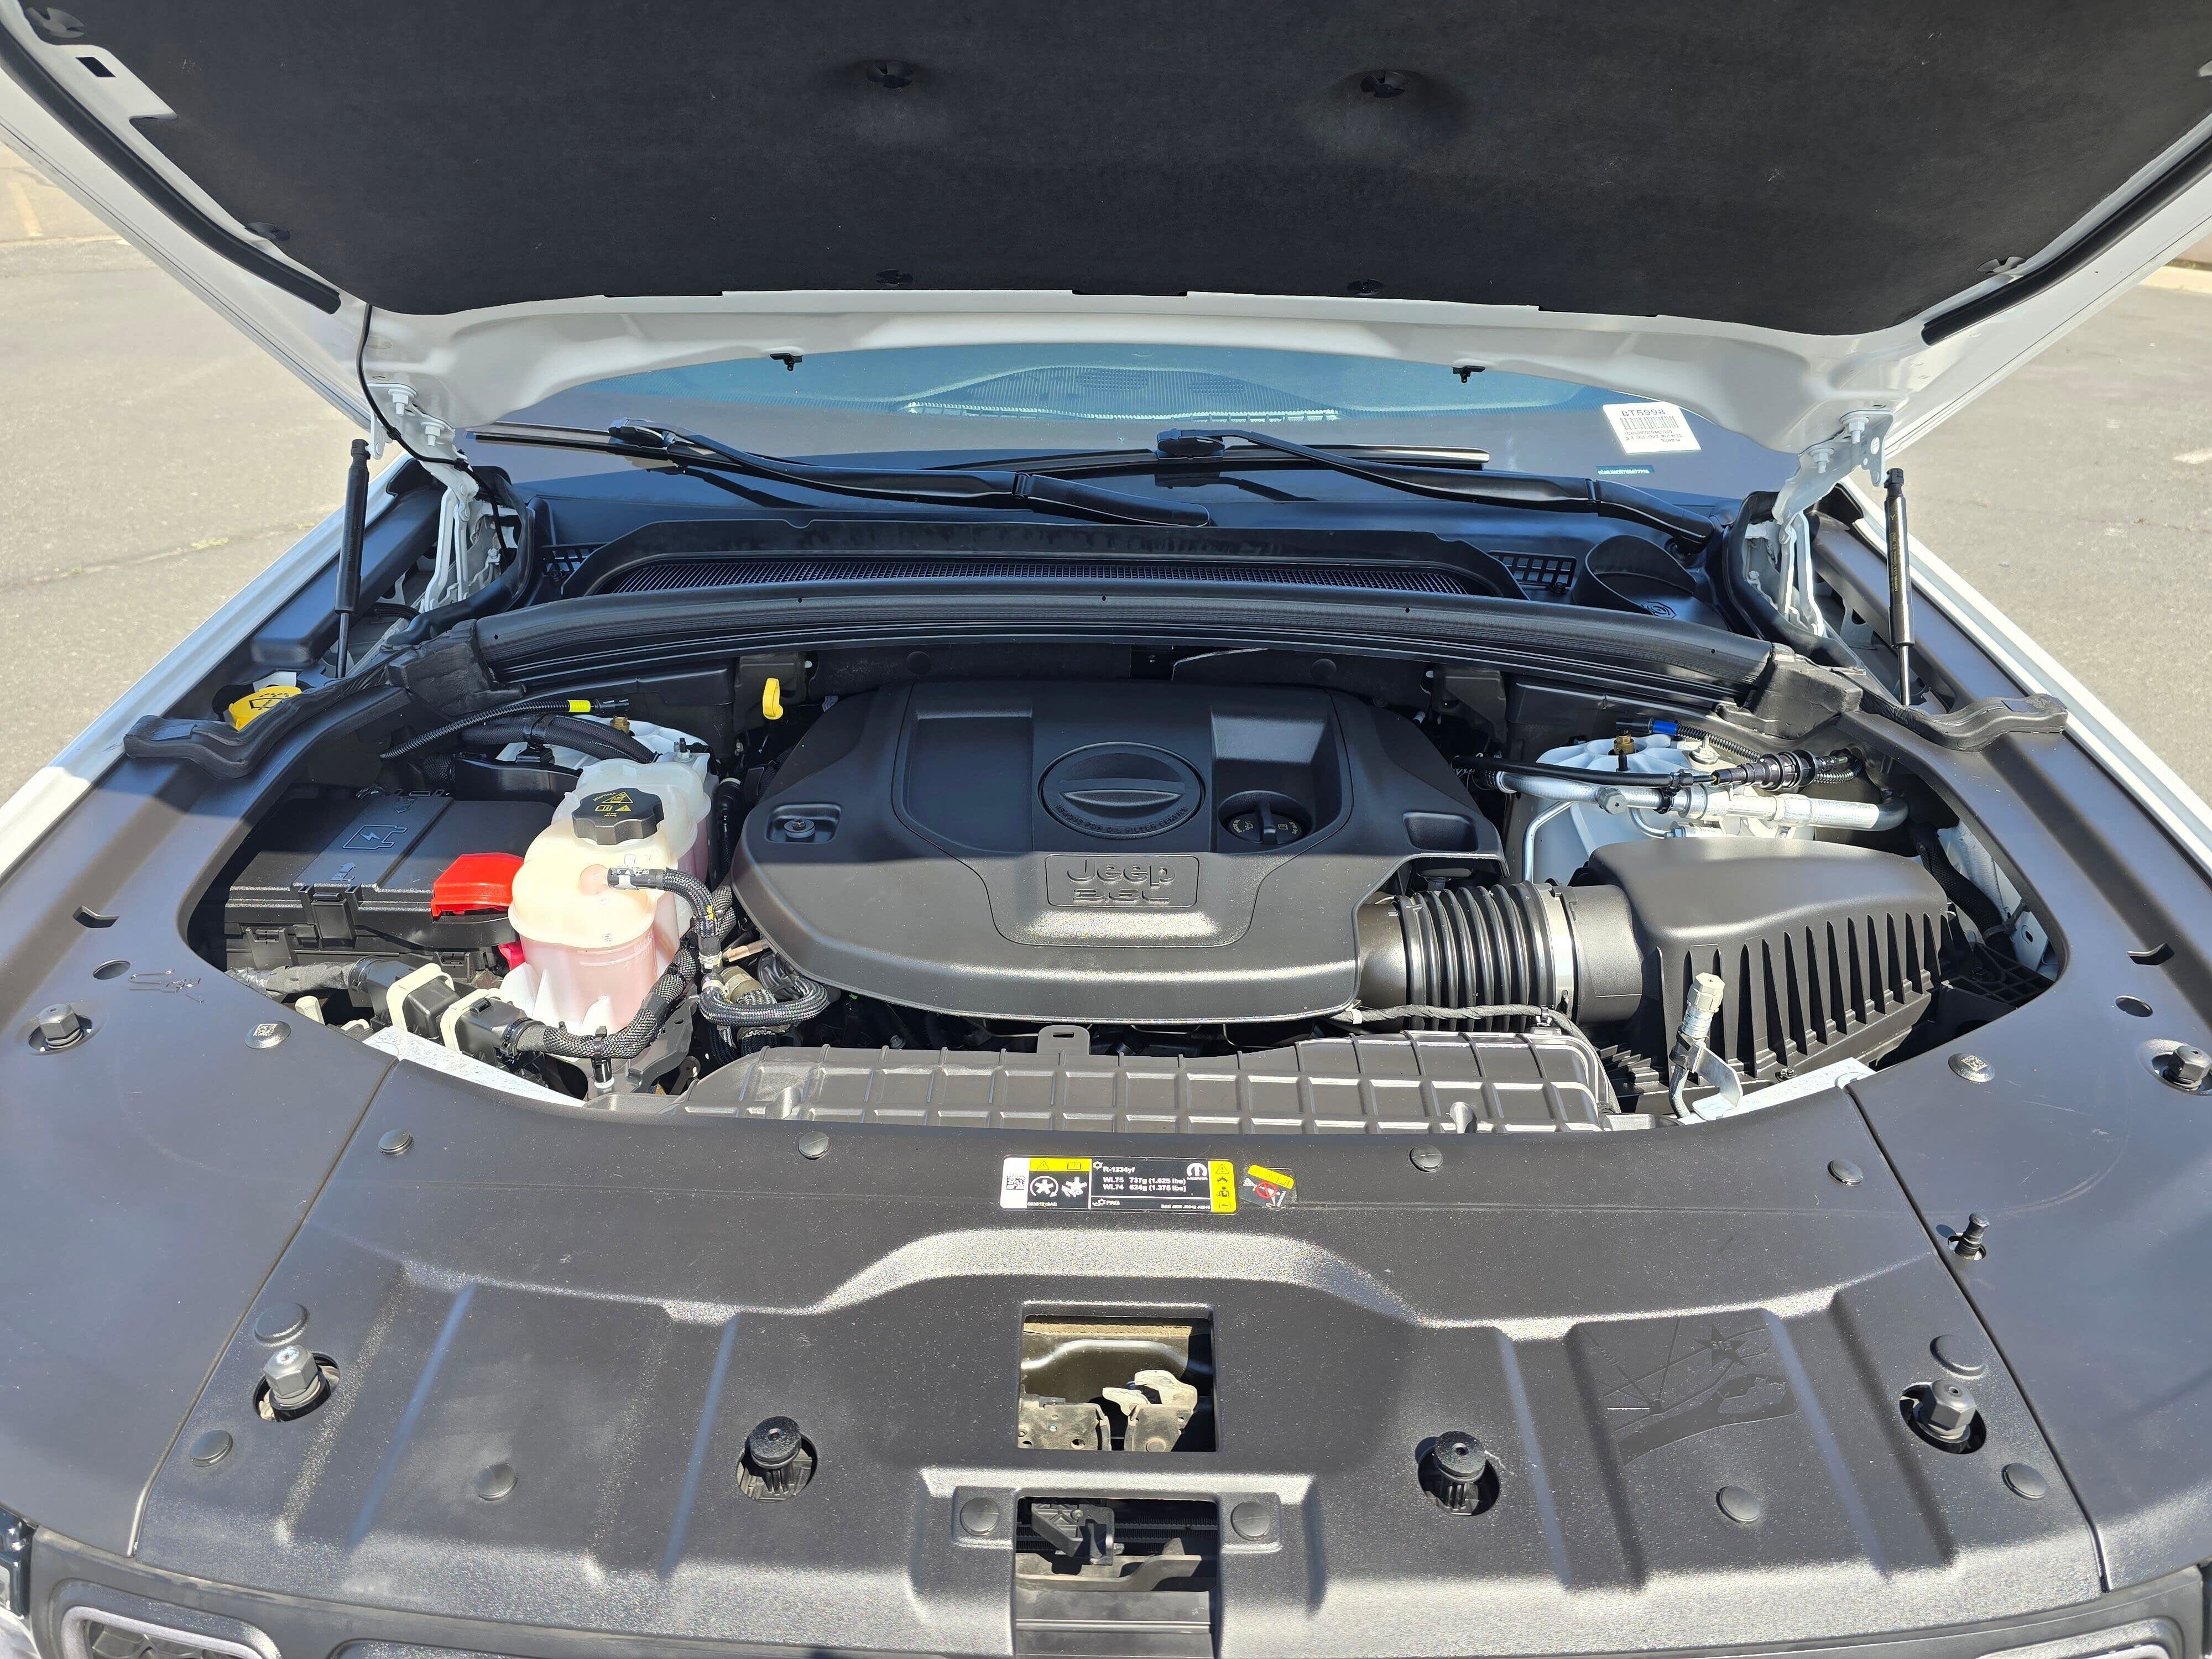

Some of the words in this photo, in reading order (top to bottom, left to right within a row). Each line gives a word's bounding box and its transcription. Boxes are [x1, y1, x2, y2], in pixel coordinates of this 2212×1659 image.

[1054, 804, 1084, 826] REMOVE
[1084, 822, 1104, 833] FOR
[1124, 823, 1156, 833] FILTER
[1067, 858, 1176, 888] Jeep
[1072, 888, 1170, 904] 3.6L
